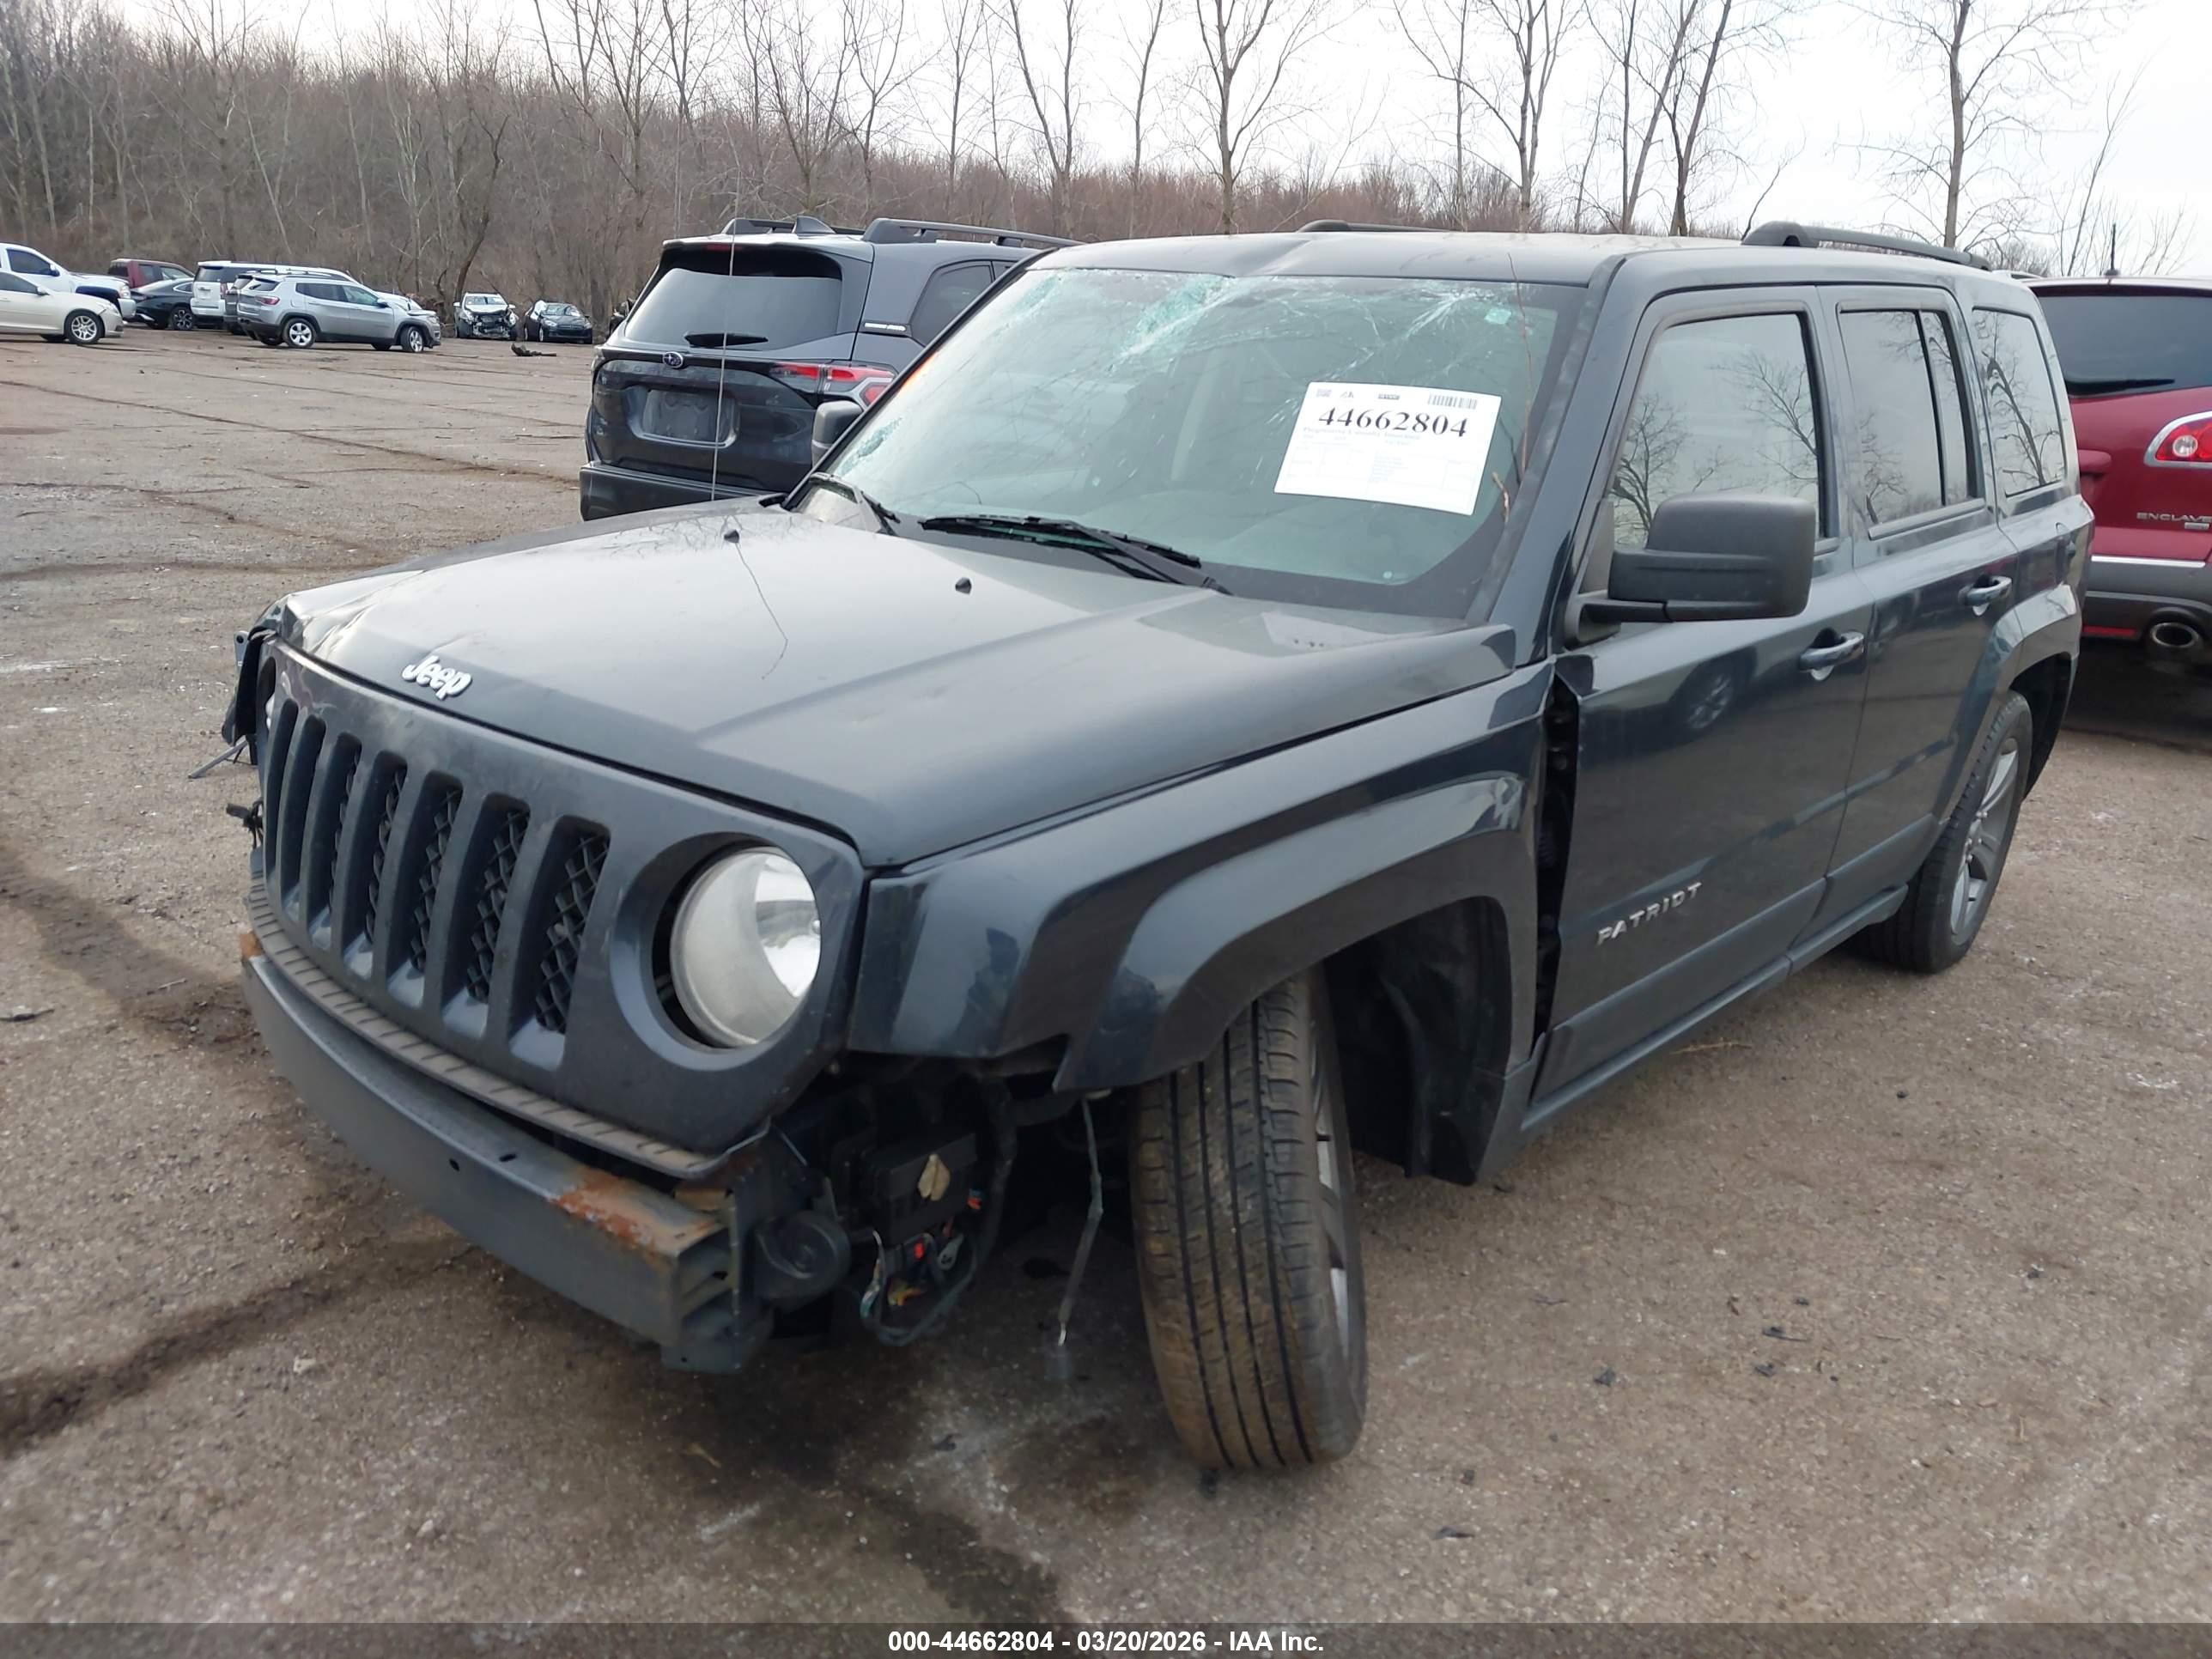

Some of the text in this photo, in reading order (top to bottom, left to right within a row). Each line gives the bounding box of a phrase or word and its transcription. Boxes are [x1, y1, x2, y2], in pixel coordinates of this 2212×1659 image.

[1318, 407, 1468, 438] 44662804
[2136, 512, 2212, 523] ENCLAVE
[401, 654, 473, 701] Jeep
[1596, 882, 1702, 946] PATRIOT
